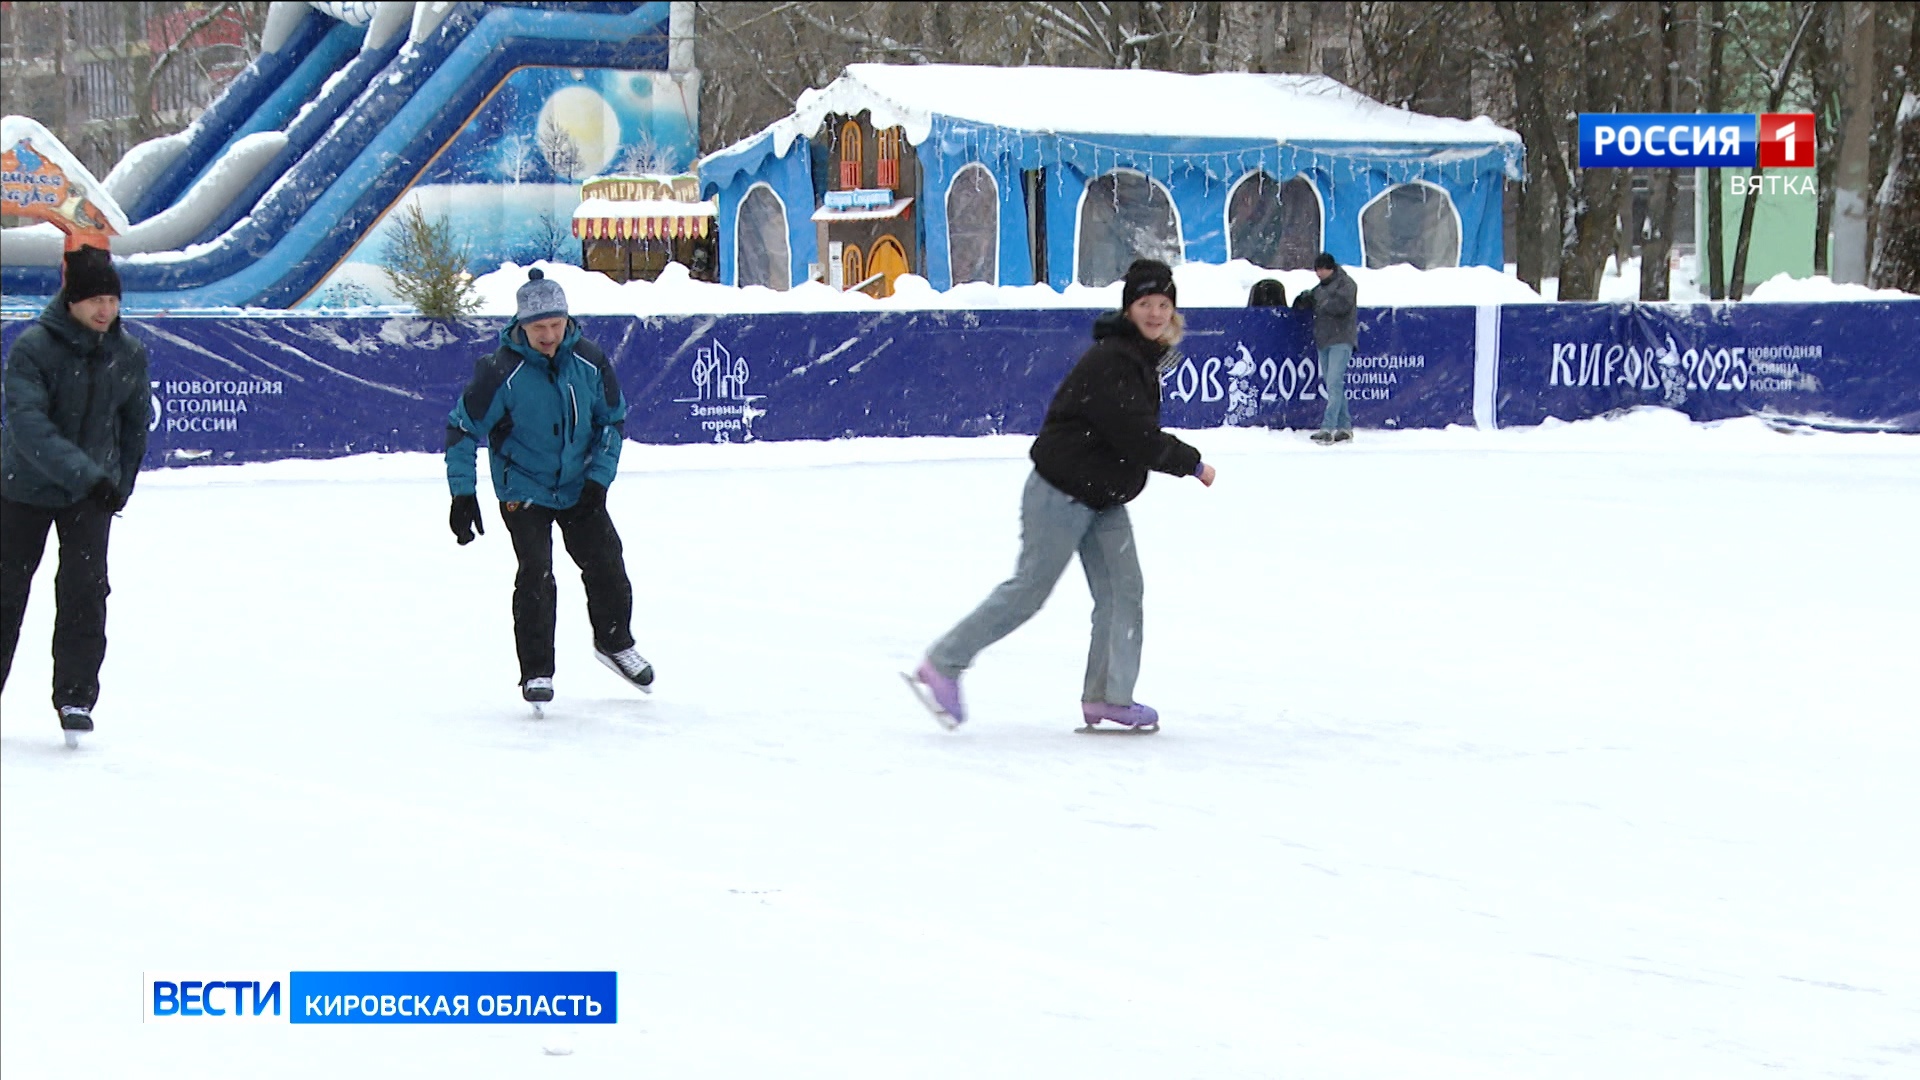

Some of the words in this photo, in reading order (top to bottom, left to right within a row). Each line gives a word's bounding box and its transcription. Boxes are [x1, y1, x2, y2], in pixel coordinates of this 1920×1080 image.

[1748, 345, 1823, 360] НОВОГОДНЯЯ
[1344, 355, 1425, 370] ОВОГОДНЯЯ
[1550, 343, 1660, 391] КИРОВ
[1682, 347, 1749, 391] 2025
[1343, 372, 1398, 386] ТОЛИЦА
[165, 380, 283, 396] НОВОГОДНЯЯ
[1342, 388, 1390, 400] ОССИИ
[166, 399, 248, 415] СТОЛИЦА
[166, 417, 238, 432] РОССИИ
[702, 420, 742, 432] город
